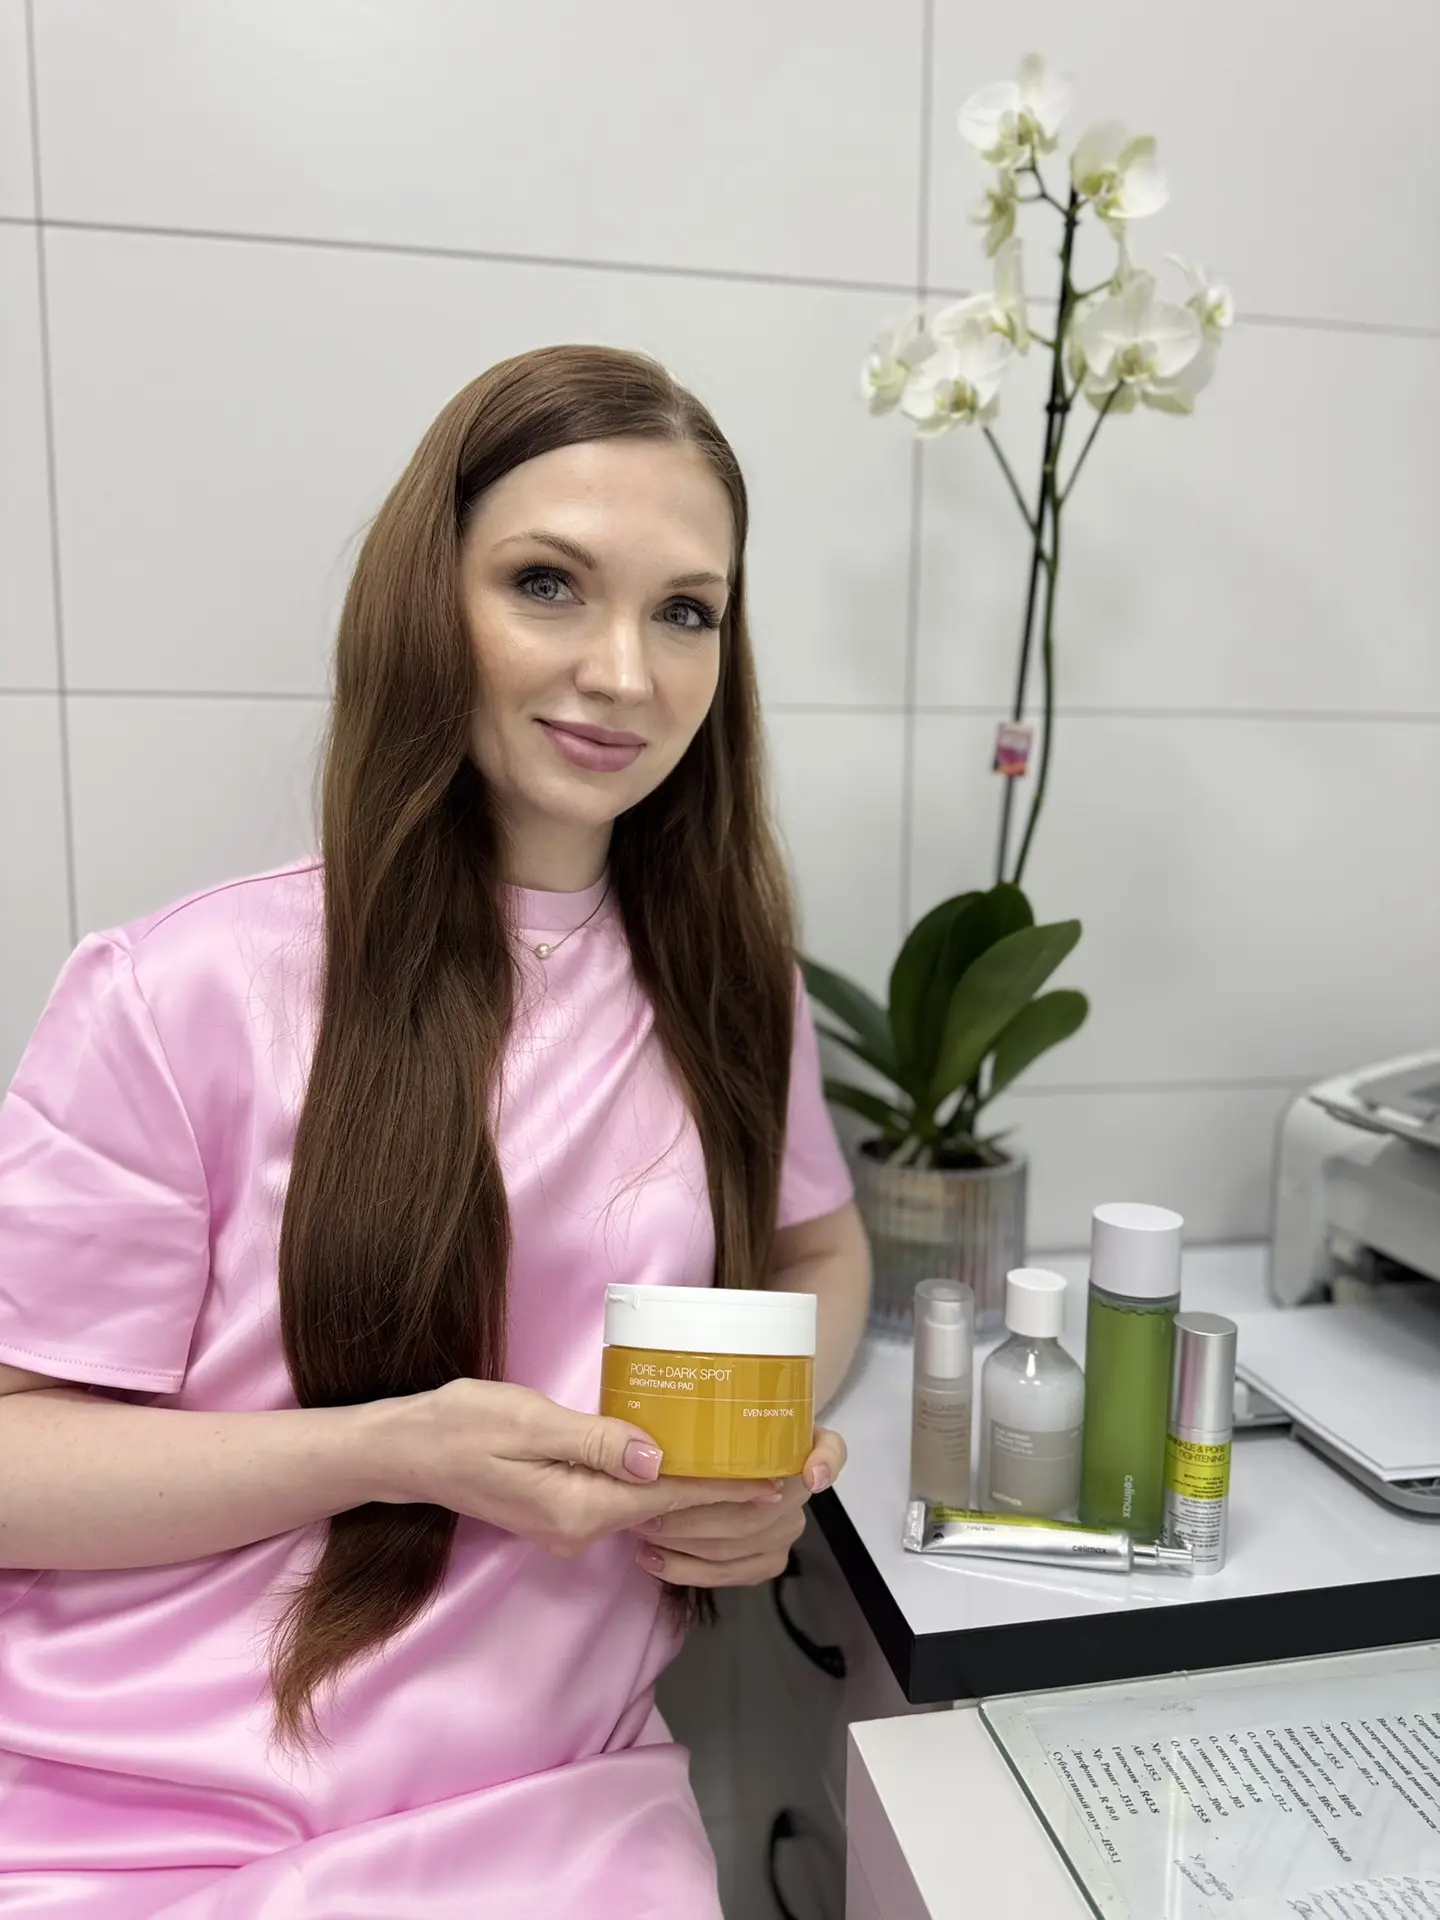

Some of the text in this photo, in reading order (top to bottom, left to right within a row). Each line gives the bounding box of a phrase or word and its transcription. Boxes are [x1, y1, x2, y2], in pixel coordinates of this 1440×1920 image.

[630, 1363, 656, 1377] PORE
[666, 1366, 698, 1380] DARK
[700, 1369, 732, 1382] SPOT
[629, 1378, 694, 1391] BRIGHTENING PAD
[627, 1401, 641, 1409] FOR
[743, 1409, 763, 1417] EVEN
[763, 1409, 779, 1417] SKIN
[1122, 1474, 1133, 1519] celimax
[1072, 1544, 1108, 1556] celimax
[1358, 1720, 1414, 1776] Аллергический
[1324, 1752, 1345, 1770] J35.1
[1143, 1763, 1162, 1782] J35.2
[1357, 1766, 1380, 1786] J01.2
[1098, 1796, 1110, 1804] R
[1139, 1790, 1160, 1814] R43.8
[1229, 1795, 1245, 1808] J03
[1242, 1783, 1263, 1803] J01.8
[1271, 1793, 1293, 1813] J31.2
[1119, 1794, 1139, 1815] J31.0
[1190, 1803, 1212, 1824] J35.8
[1208, 1797, 1229, 1817] J06.9
[1317, 1796, 1342, 1818] H65.1
[1338, 1794, 1362, 1817] H60.9
[1326, 1837, 1352, 1862] H66.0
